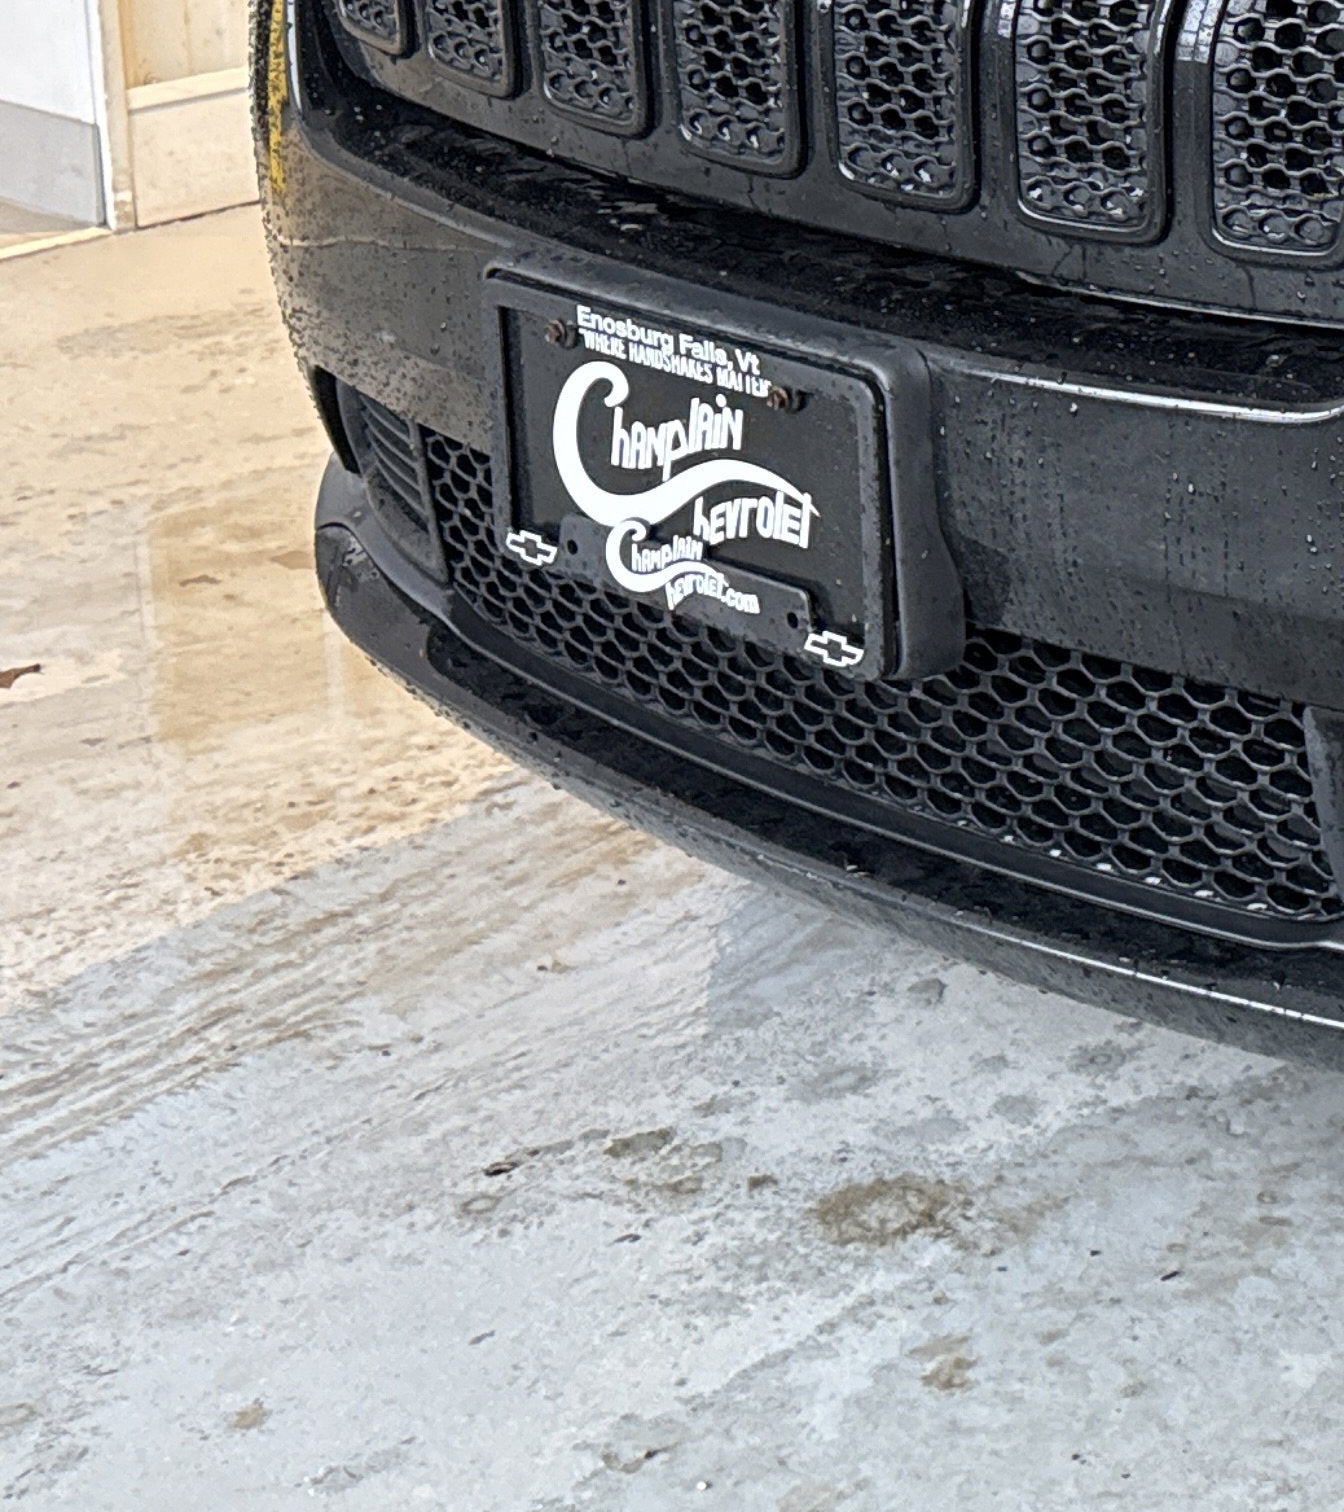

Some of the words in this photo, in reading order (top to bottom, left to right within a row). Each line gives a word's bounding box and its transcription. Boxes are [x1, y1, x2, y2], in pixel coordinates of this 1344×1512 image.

[577, 305, 674, 354] Enosburg
[679, 333, 733, 369] Falls,
[735, 348, 760, 376] Vt
[629, 343, 713, 384] HANDSHAKES
